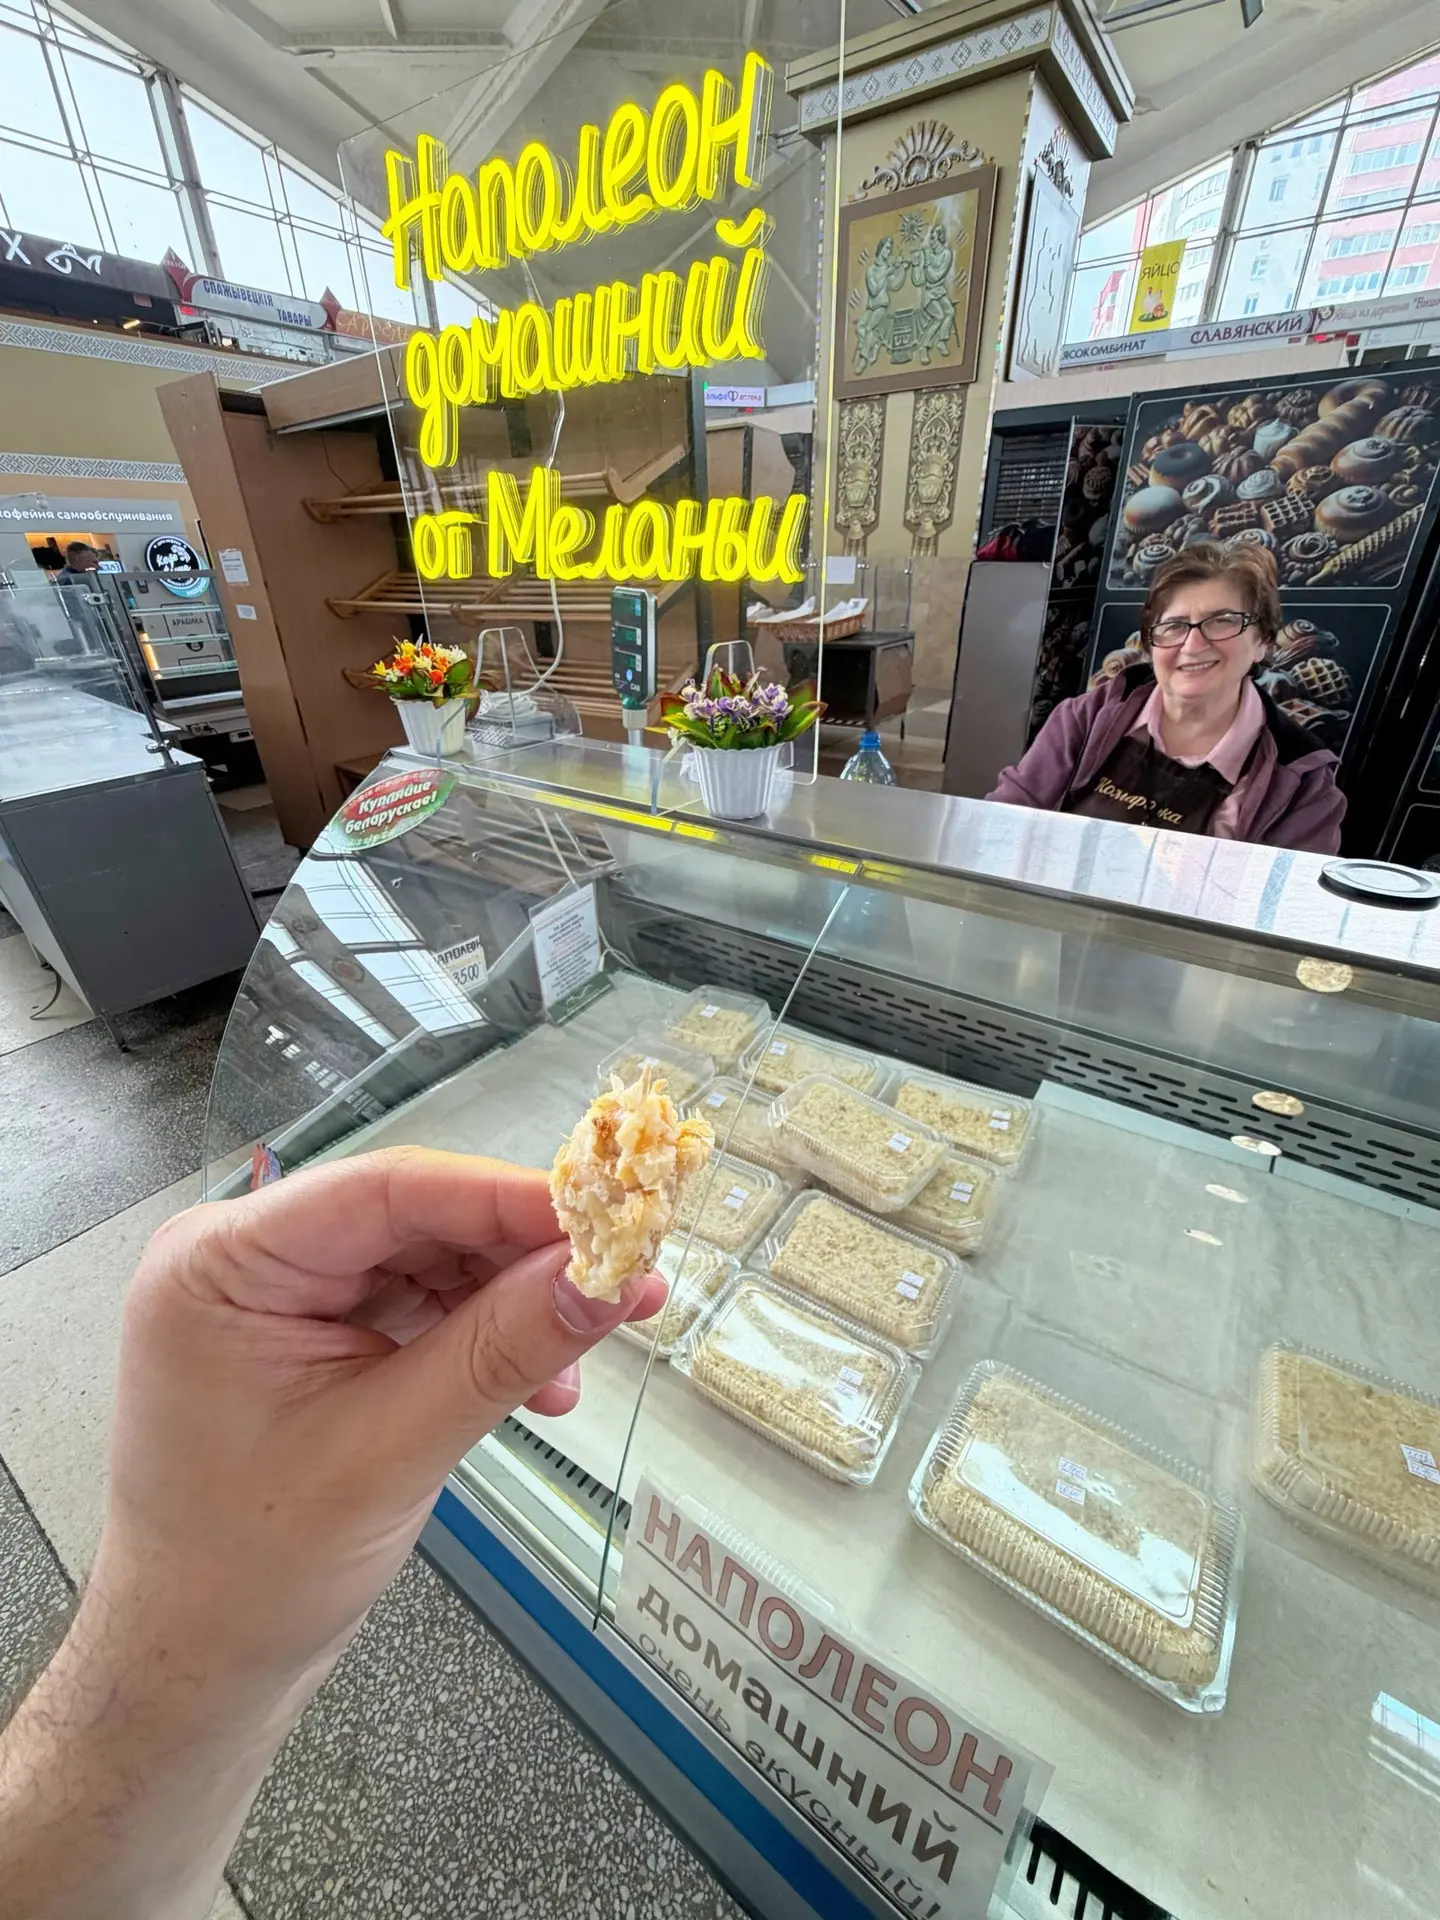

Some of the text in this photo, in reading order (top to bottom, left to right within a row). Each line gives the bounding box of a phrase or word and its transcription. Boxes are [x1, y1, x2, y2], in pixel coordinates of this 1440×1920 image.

[382, 52, 768, 289] Наполеон
[203, 280, 274, 307] СПАЖЫВЕЦКІЯ
[276, 308, 313, 327] ТАВАРЫ
[1190, 315, 1304, 345] СЛАВЯНСКИЙ
[405, 208, 769, 467] домашний
[57, 510, 173, 523] самообслуживания
[414, 509, 475, 580] от
[638, 1633, 731, 1734] очень
[644, 1495, 1014, 1817] НАПОЛЕОН
[637, 1583, 960, 1886] домашний
